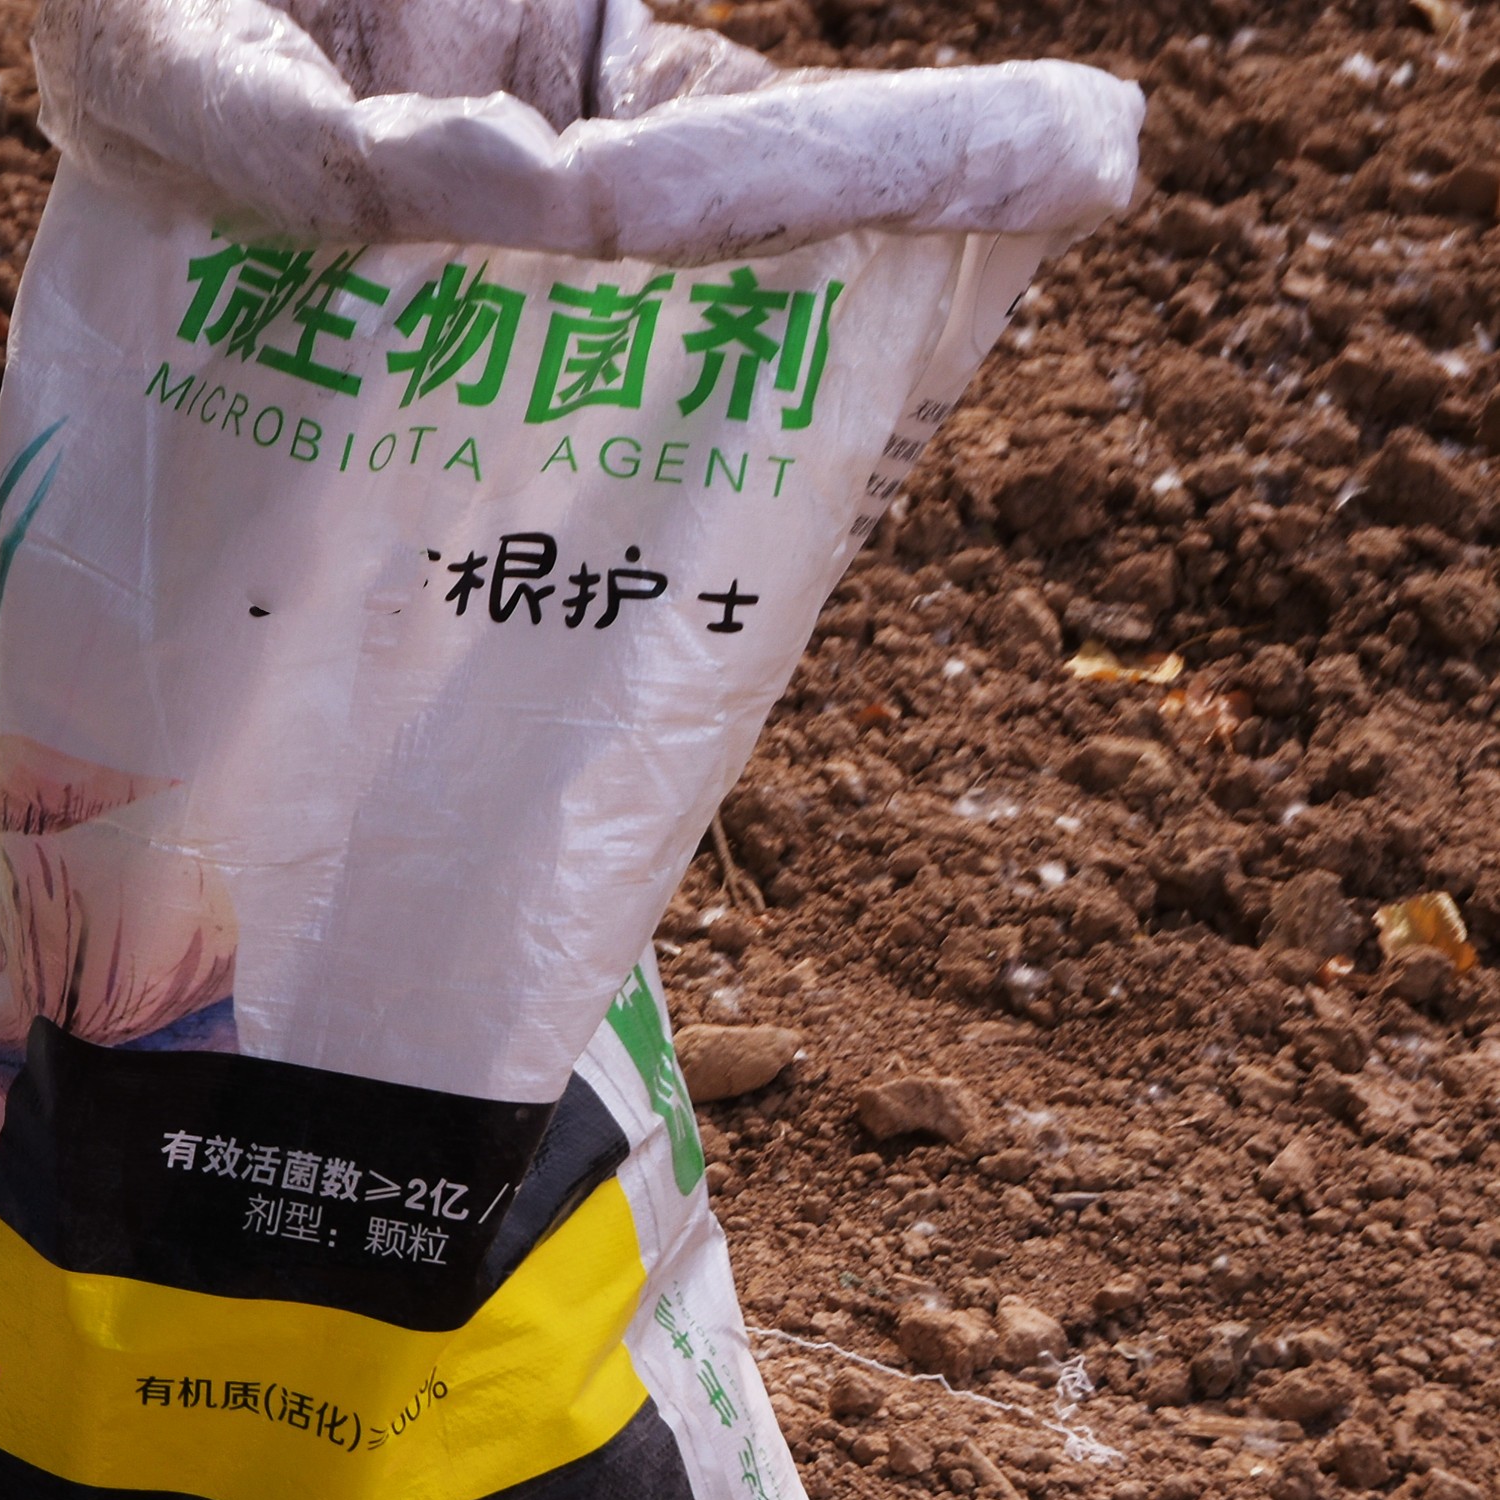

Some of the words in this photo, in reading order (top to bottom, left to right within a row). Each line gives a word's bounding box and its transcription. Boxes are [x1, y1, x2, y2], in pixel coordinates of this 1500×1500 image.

[175, 222, 846, 431] 微生物菌剂
[145, 361, 488, 483] MICROBIOTA
[540, 434, 797, 500] AGENT
[241, 1192, 451, 1266] 剂型：颗粒
